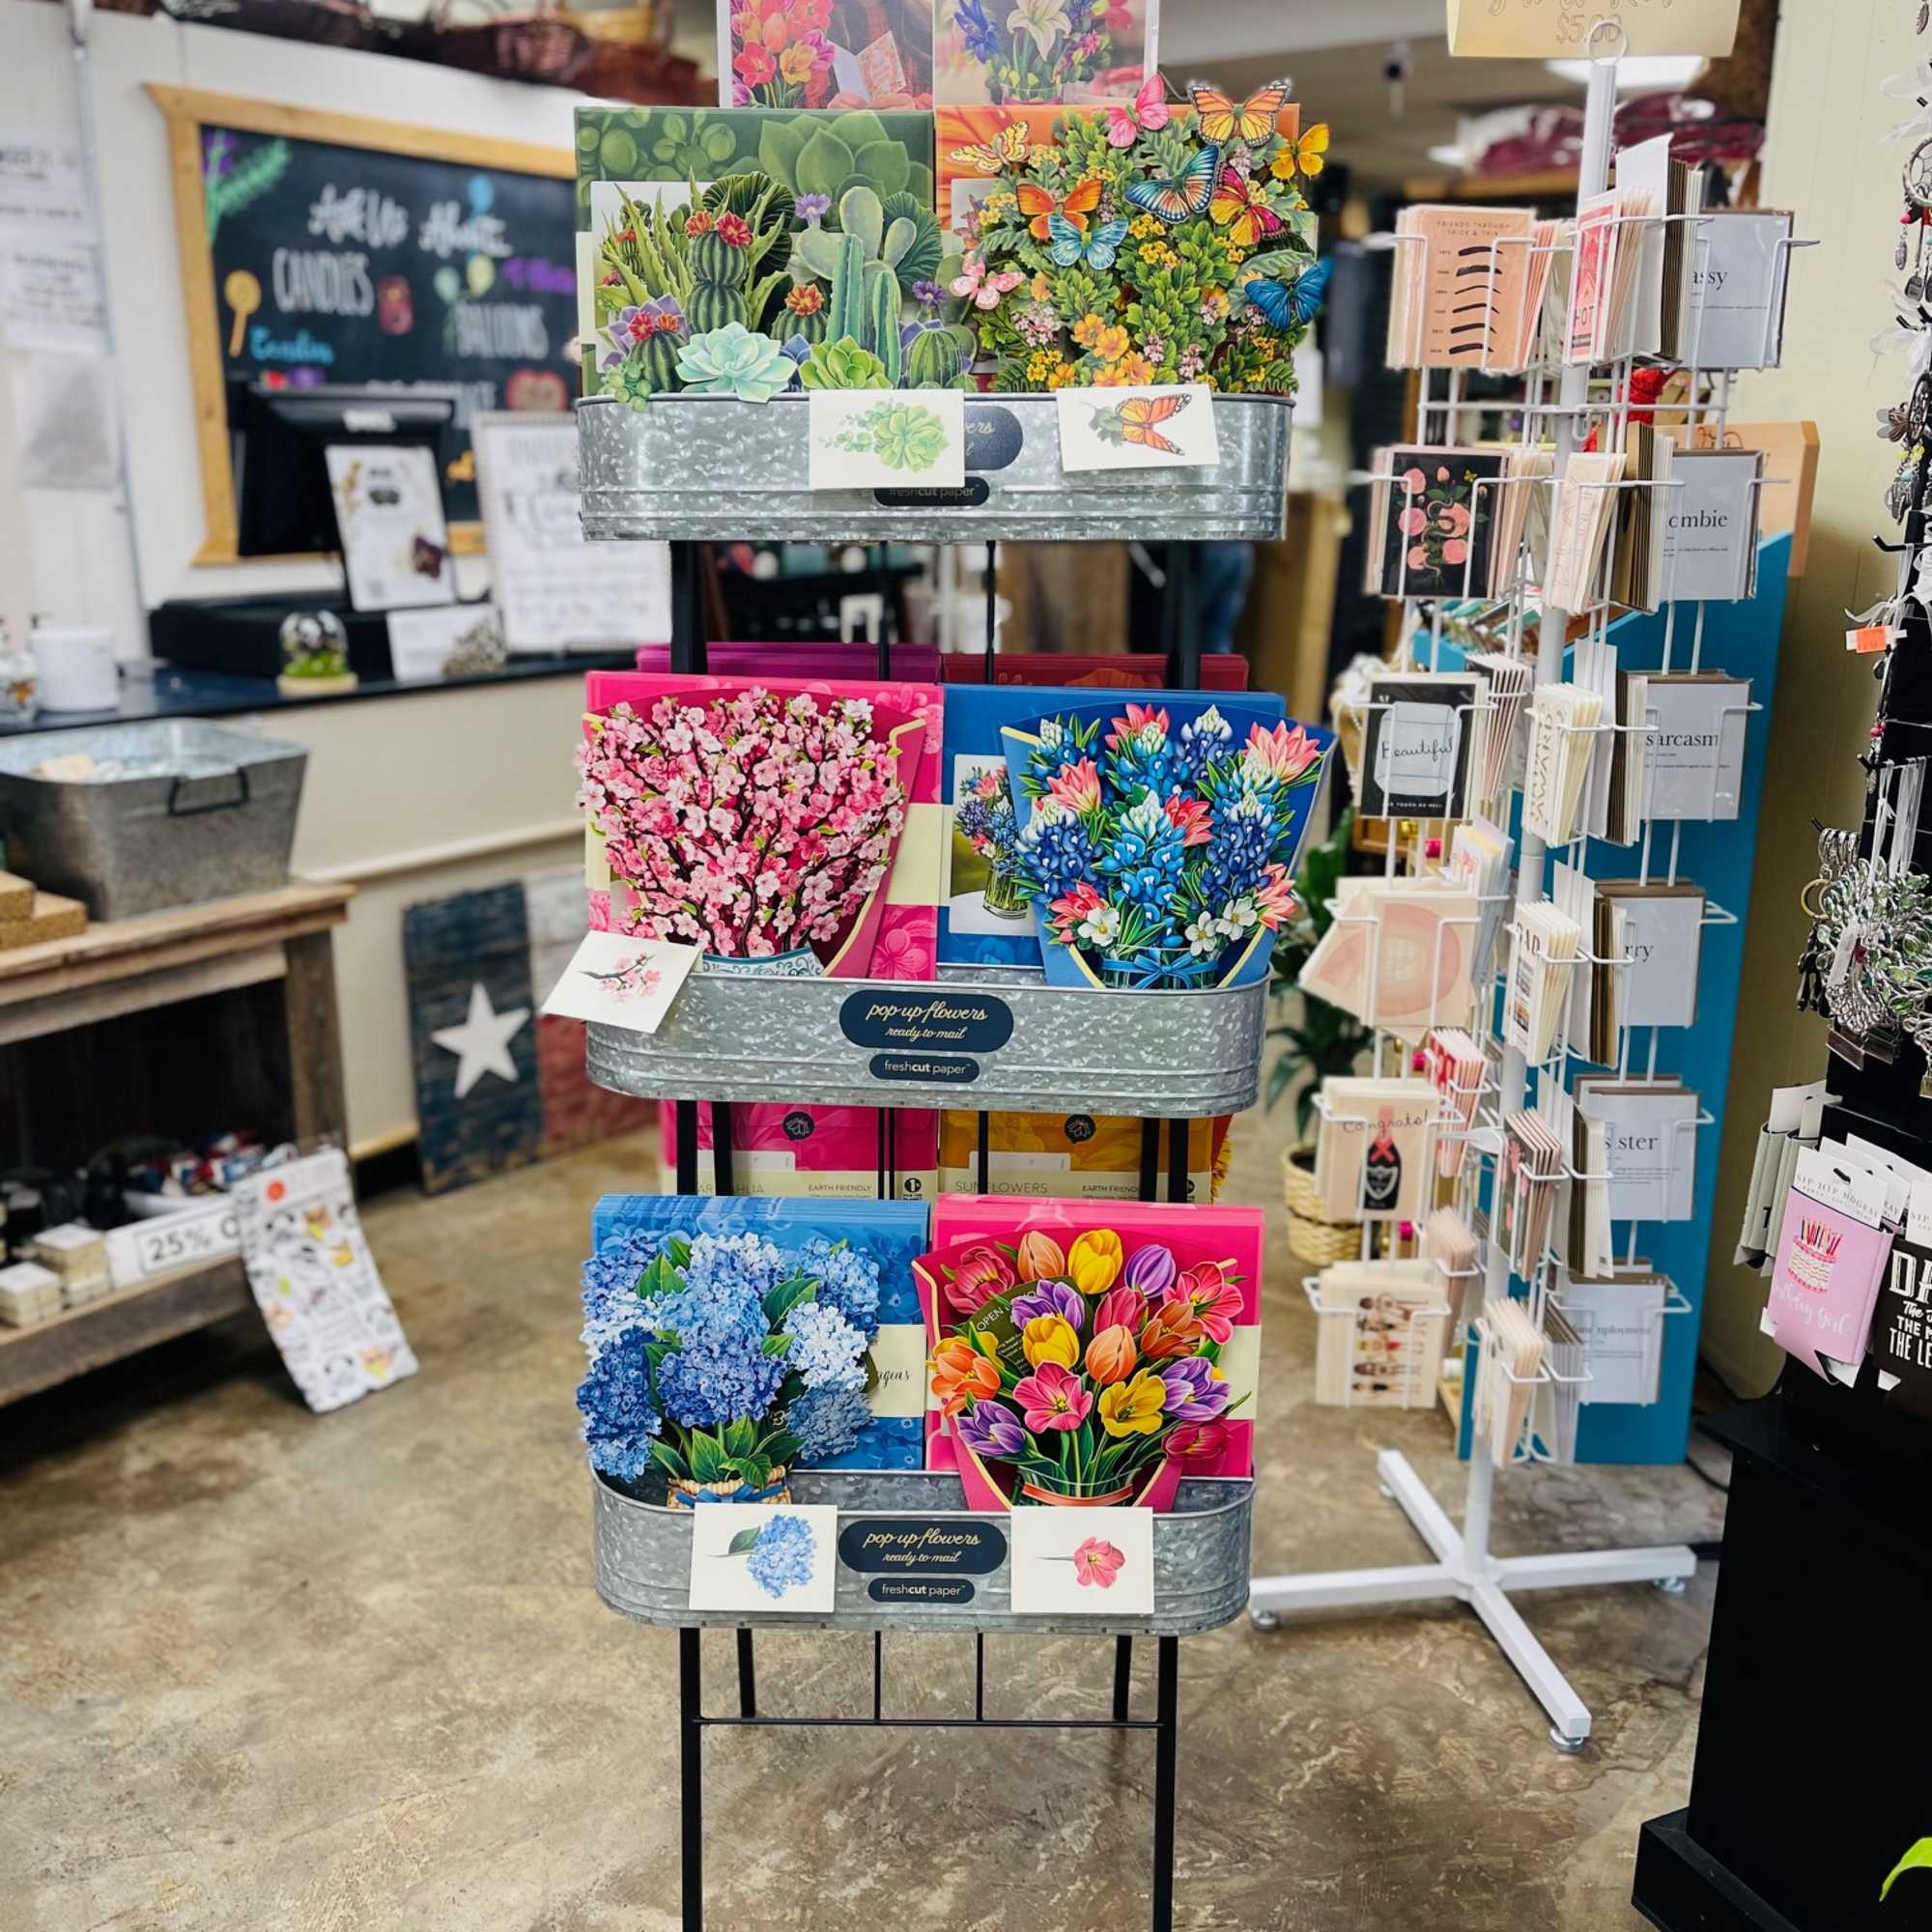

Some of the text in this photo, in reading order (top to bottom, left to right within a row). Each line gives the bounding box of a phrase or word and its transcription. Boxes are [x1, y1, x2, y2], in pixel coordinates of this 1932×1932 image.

[921, 1000, 988, 1024] flowers
[885, 1027, 968, 1042] ready to mail
[885, 1060, 966, 1075] freshcut paper
[1605, 1135, 1659, 1151] sster
[808, 1183, 871, 1193] EARTH FRIENDLY
[954, 1180, 1048, 1194] SUNLOWERS
[1081, 1184, 1139, 1194] EARTH FRIEND
[148, 1223, 212, 1262] 25%
[1889, 1248, 1932, 1304] DA
[1902, 1300, 1924, 1318] The
[976, 1306, 1005, 1331] OPEN
[1896, 1315, 1921, 1336] THE
[1889, 1326, 1913, 1361] THE
[917, 1527, 981, 1549] flowers
[882, 1550, 962, 1567] ready to mail
[881, 1583, 961, 1598] freshcut paper
